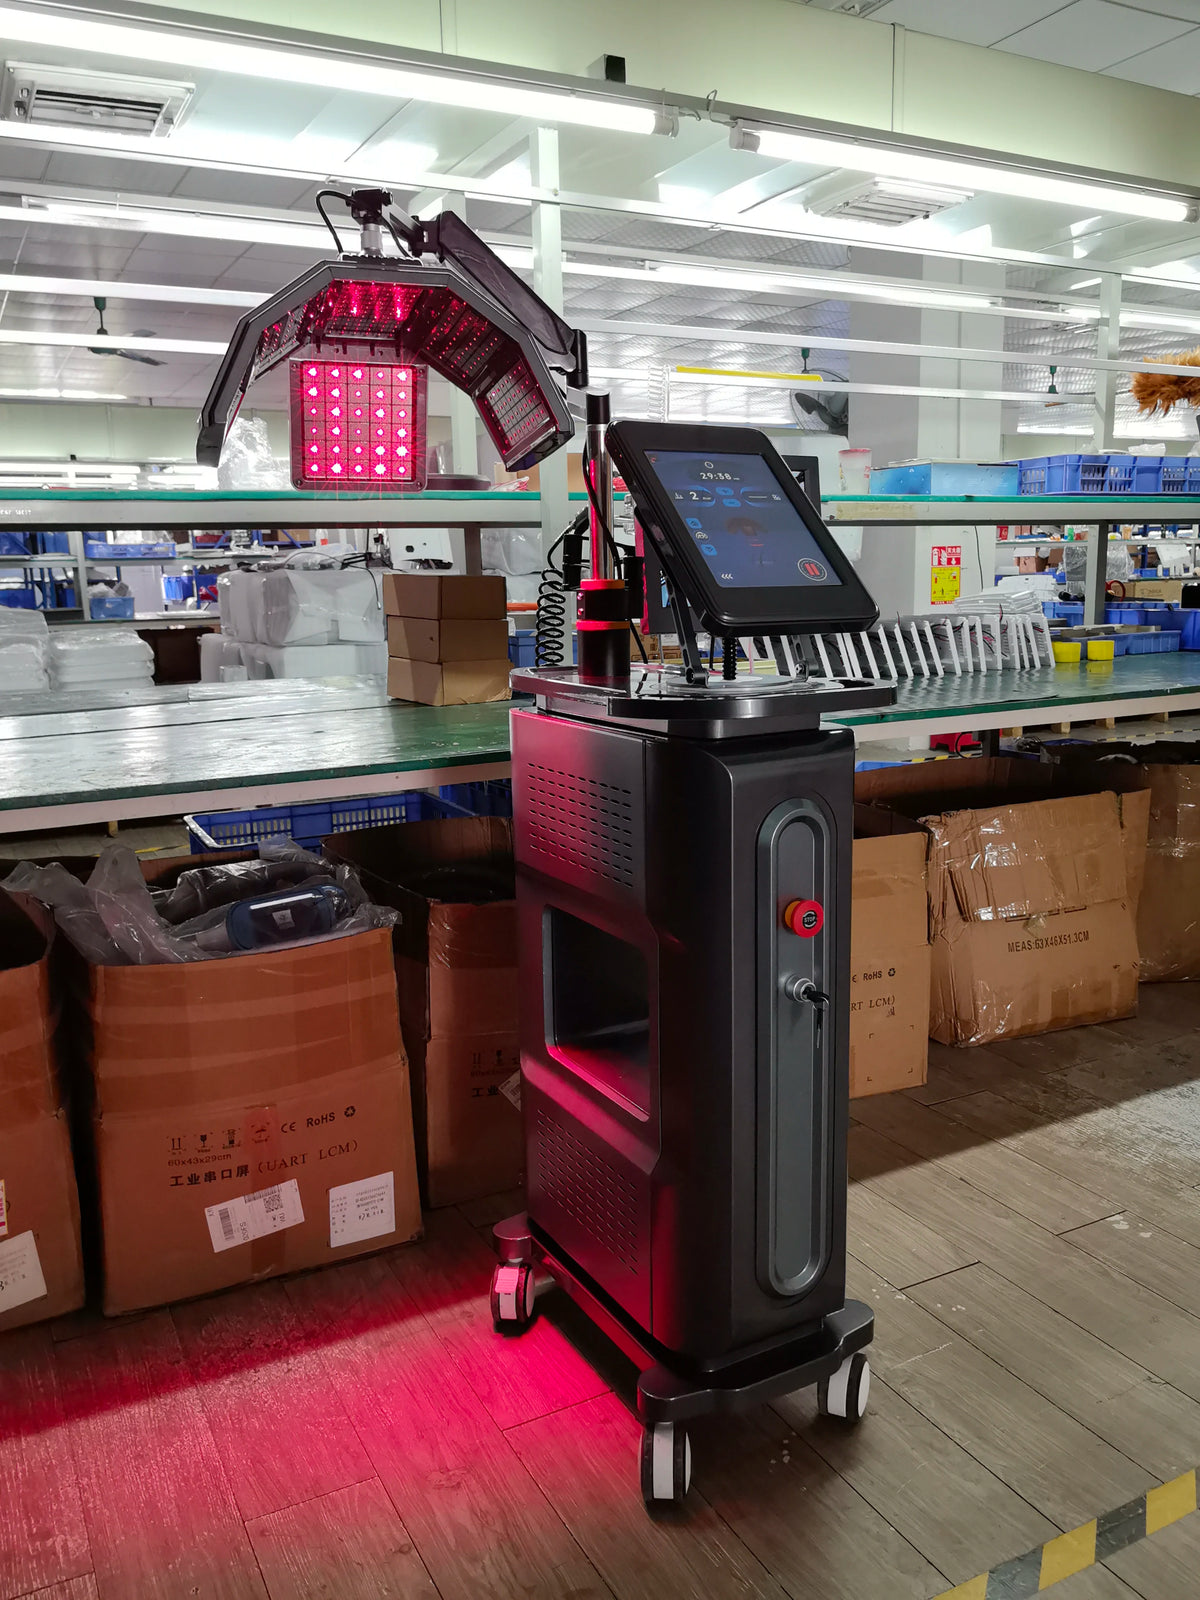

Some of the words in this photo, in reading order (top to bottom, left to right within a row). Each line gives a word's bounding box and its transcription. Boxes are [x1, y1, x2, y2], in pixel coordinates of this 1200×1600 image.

[689, 491, 699, 500] 2
[863, 970, 883, 981] RoHS
[471, 1085, 499, 1098] 工业
[306, 1112, 336, 1128] RoHS
[167, 1152, 232, 1167] 60x43x29cm
[169, 1164, 250, 1187] 工业串口屏
